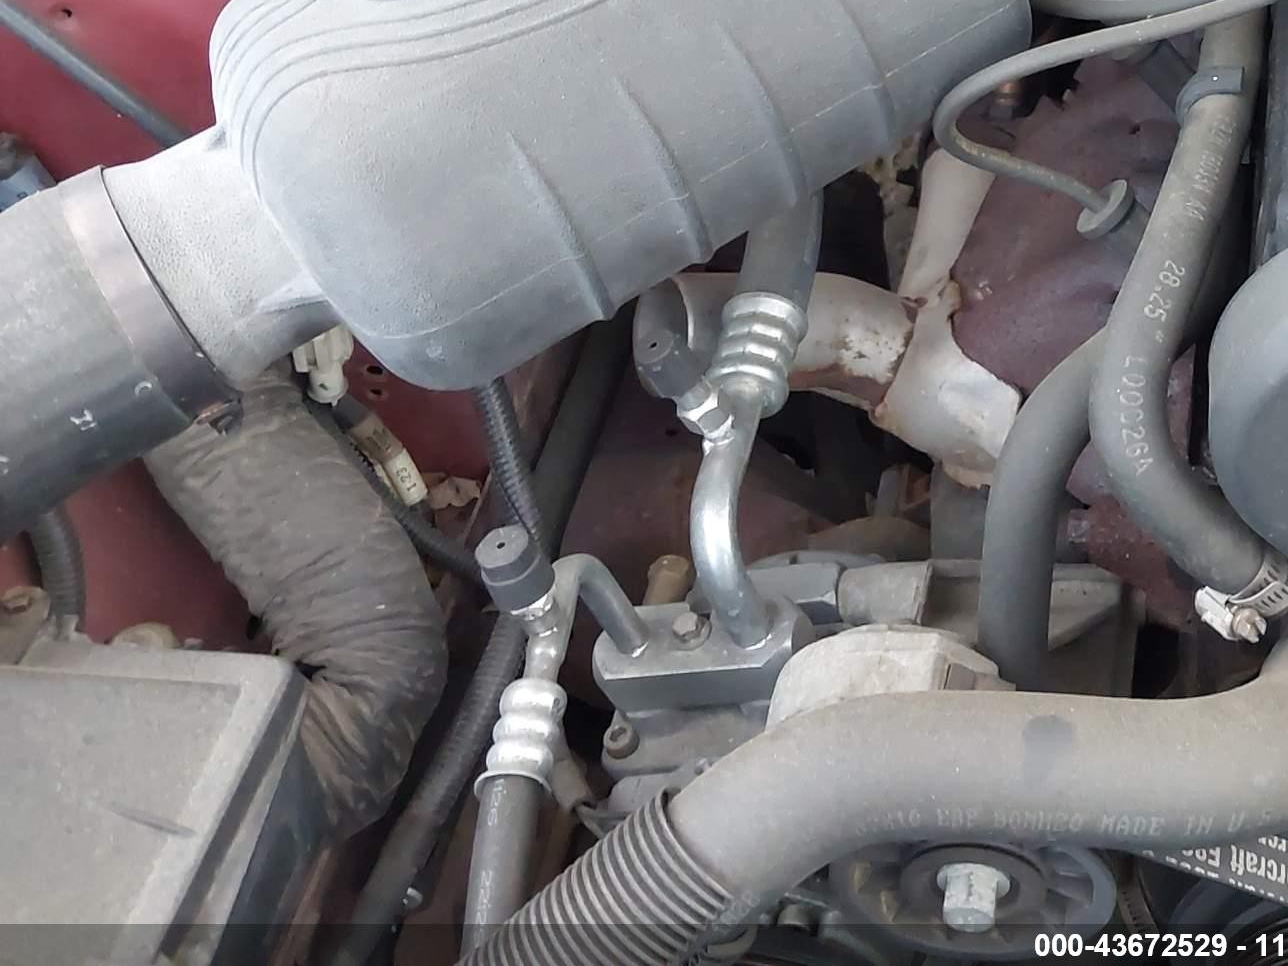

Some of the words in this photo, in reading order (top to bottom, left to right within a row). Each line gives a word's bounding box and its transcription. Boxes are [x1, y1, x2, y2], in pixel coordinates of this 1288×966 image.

[1144, 259, 1186, 322] 28.25
[1099, 811, 1164, 836] MADE
[1183, 815, 1215, 837] IN
